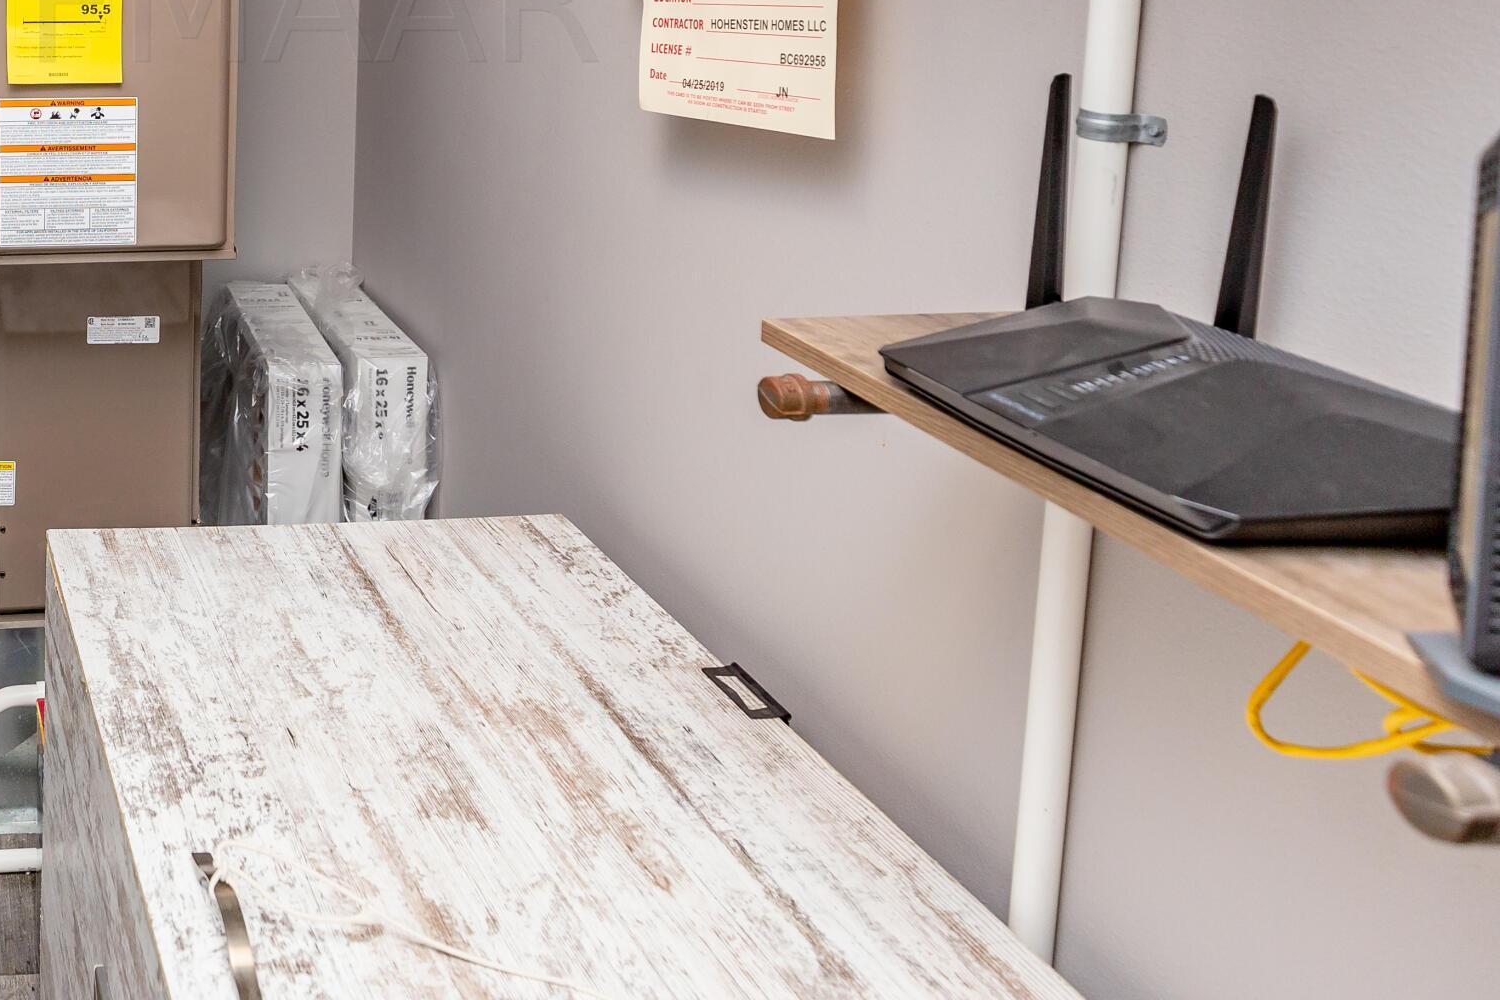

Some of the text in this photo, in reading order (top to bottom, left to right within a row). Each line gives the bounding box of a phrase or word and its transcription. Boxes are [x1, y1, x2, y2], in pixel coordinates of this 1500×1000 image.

[81, 4, 111, 15] 95.5
[652, 17, 827, 32] CONTRACTOR HOHENSTEIN HOMES LLC
[651, 43, 692, 56] LICENSE #
[779, 53, 827, 67] BC692958
[649, 68, 667, 81] Date
[682, 78, 725, 92] 04/25/2019
[775, 86, 789, 98] JN
[375, 368, 389, 387] 16
[296, 400, 307, 408] x
[375, 400, 389, 418] 25
[296, 411, 310, 429] 25
